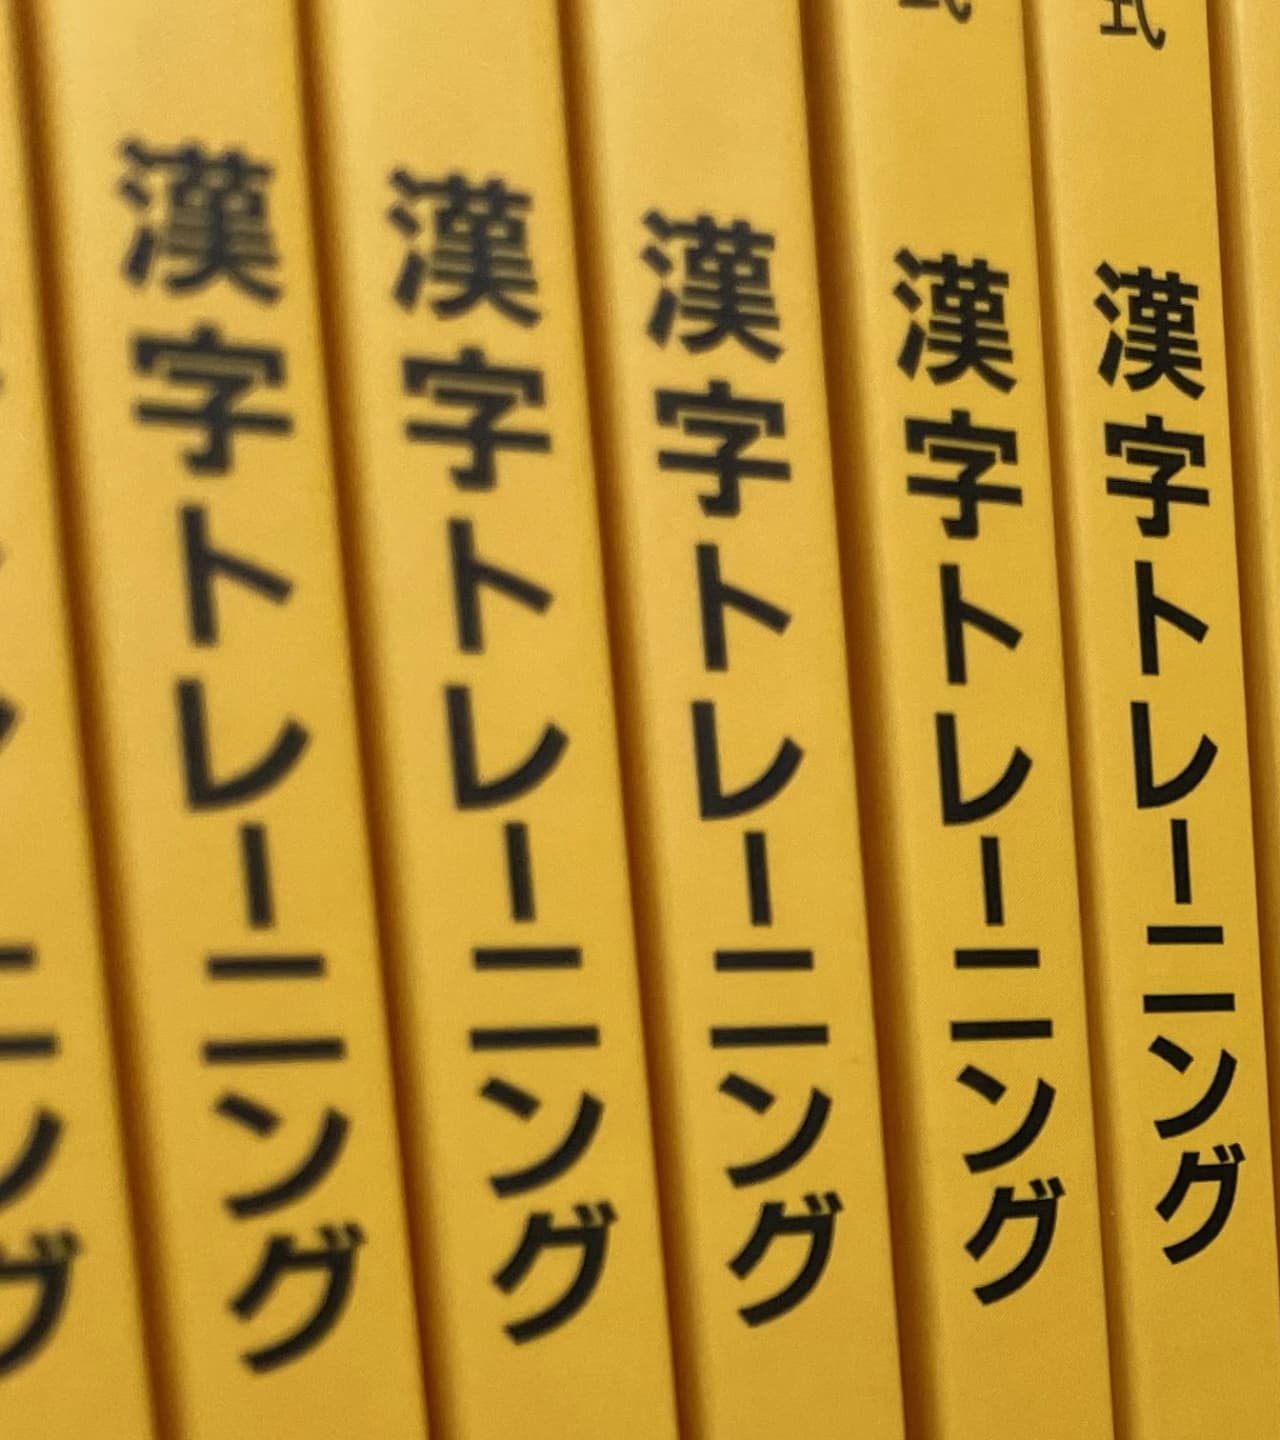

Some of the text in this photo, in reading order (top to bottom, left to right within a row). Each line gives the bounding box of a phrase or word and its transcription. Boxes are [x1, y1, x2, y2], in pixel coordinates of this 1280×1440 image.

[118, 138, 366, 1375] 漢字トレーニング
[387, 165, 618, 1347] 漢字トレーニング
[640, 208, 842, 1328] 漢字トレーニング
[893, 247, 1065, 1305] 漢字トレーニング
[1094, 261, 1247, 1265] 漢字トレーニング
